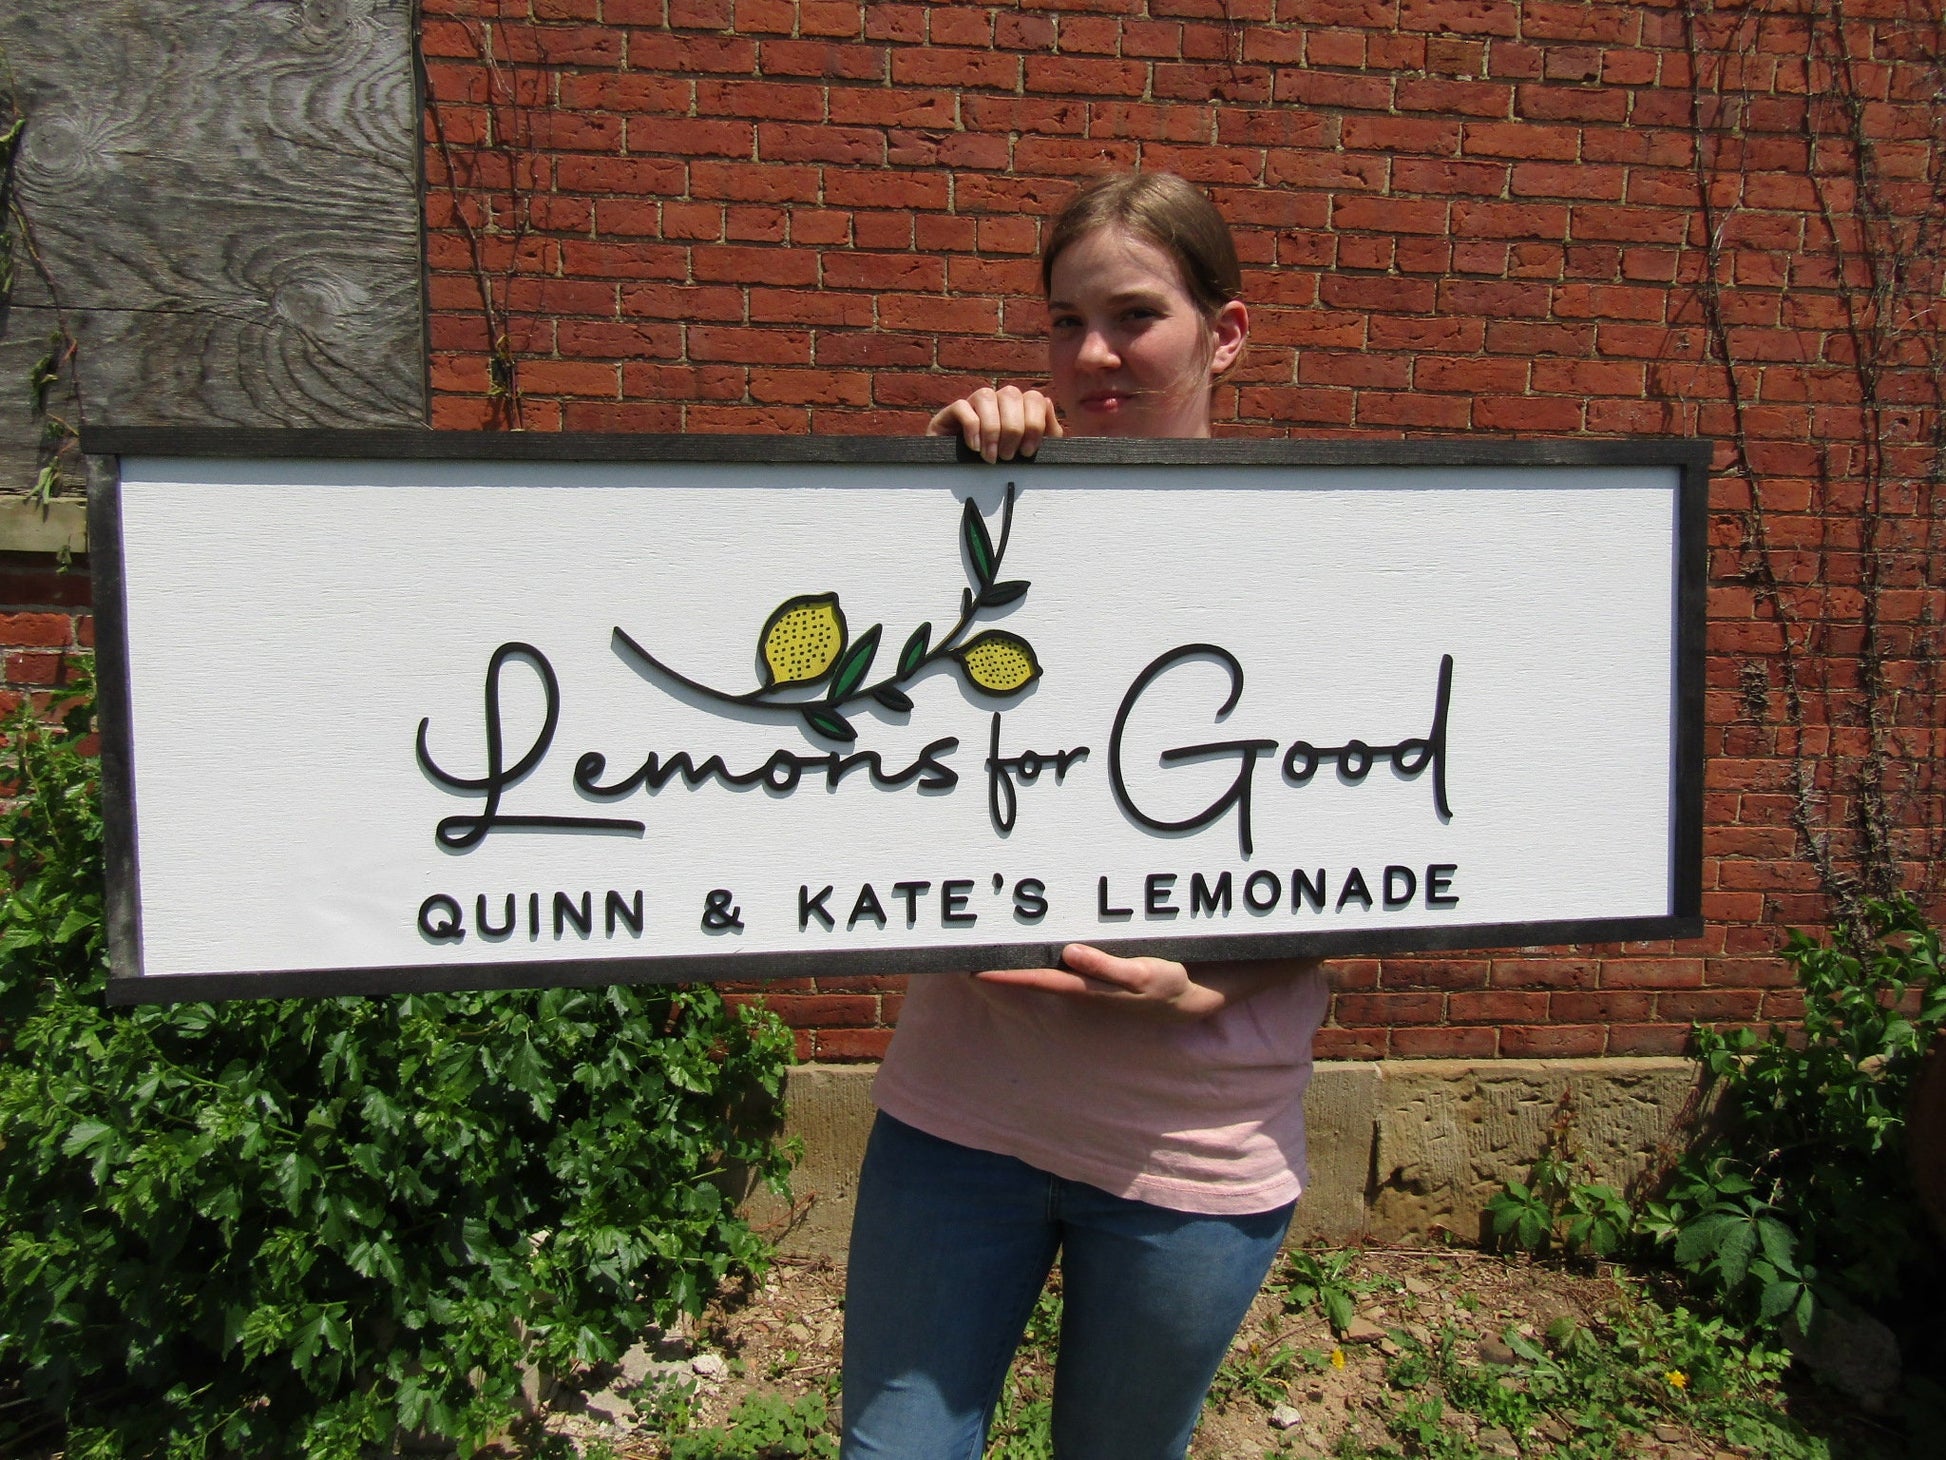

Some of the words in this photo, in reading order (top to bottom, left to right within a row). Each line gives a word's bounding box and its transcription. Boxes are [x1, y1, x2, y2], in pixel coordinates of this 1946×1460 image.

[416, 641, 960, 850] Lemons
[985, 711, 1091, 833] for
[1109, 643, 1454, 857] Good
[417, 889, 645, 940] QUINN
[701, 889, 745, 931] &
[798, 872, 1049, 927] KATE'S
[1098, 863, 1460, 921] LEMONADE
